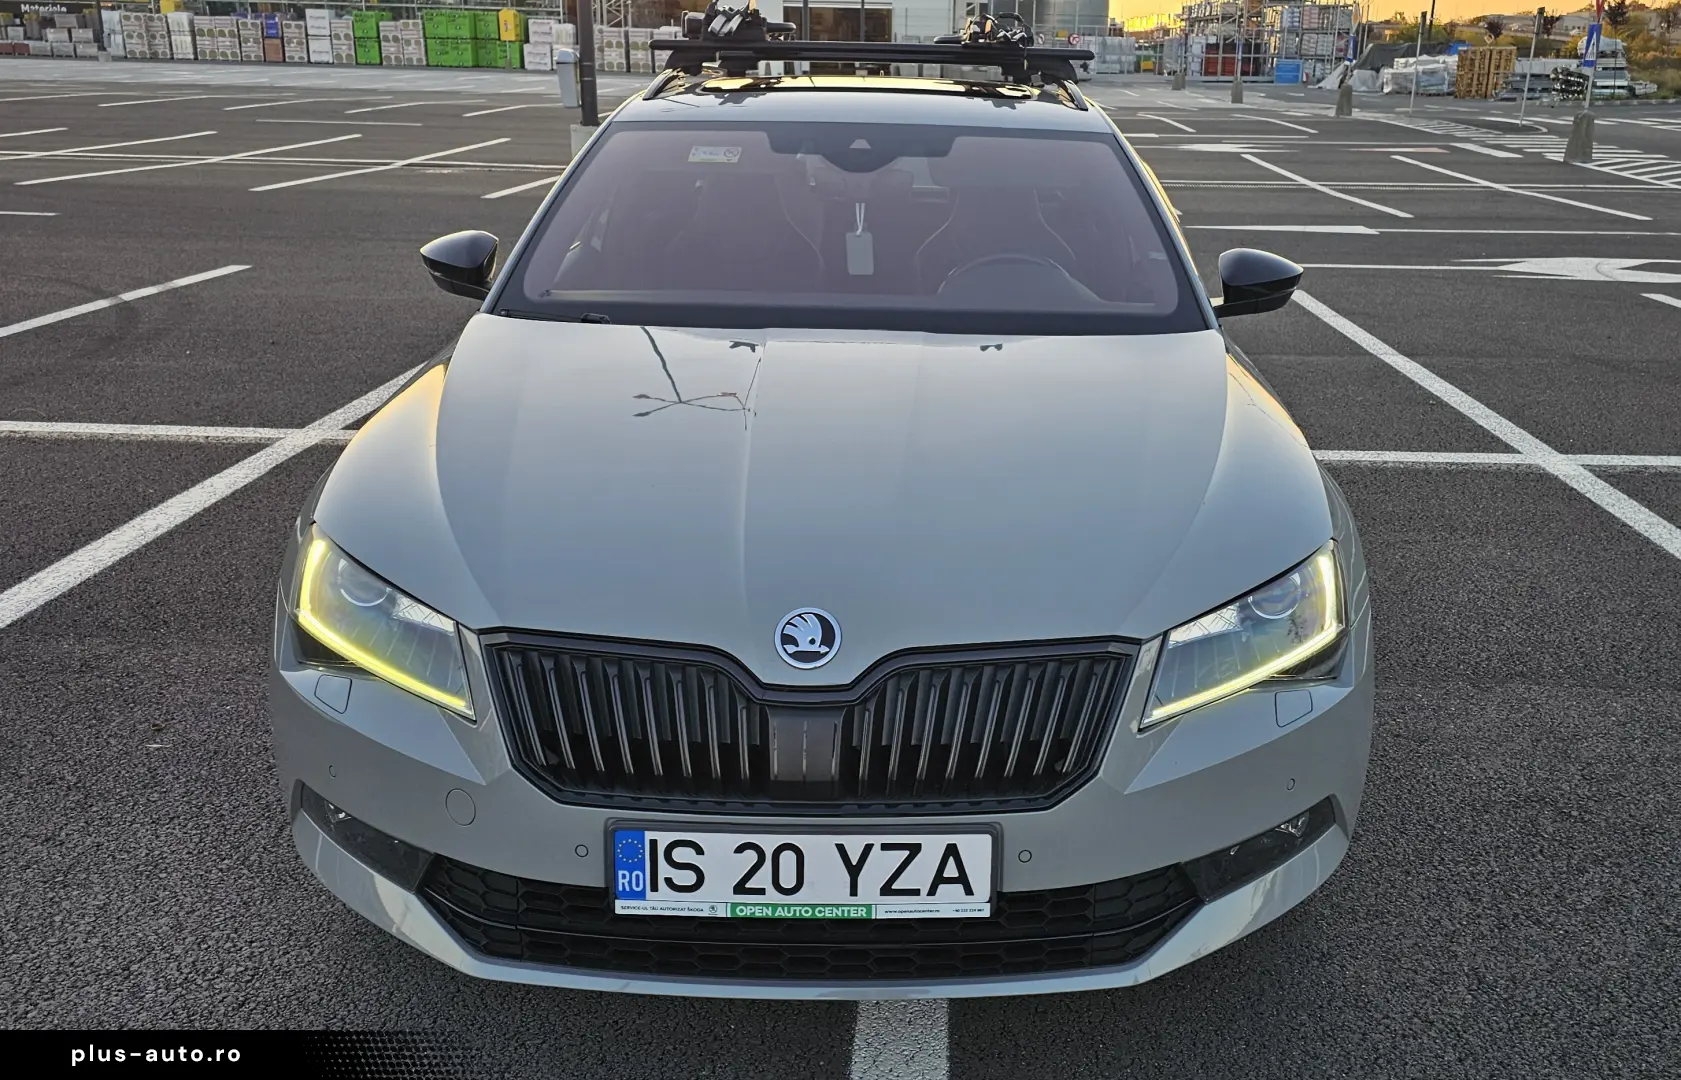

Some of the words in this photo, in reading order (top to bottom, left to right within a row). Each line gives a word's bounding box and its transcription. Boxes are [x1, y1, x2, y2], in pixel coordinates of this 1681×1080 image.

[649, 839, 705, 893] IS
[732, 841, 805, 896] 20
[834, 843, 974, 897] YZA
[617, 870, 644, 892] RO
[735, 905, 772, 917] OPEN
[774, 906, 813, 917] AUTO
[814, 906, 867, 918] CENTER
